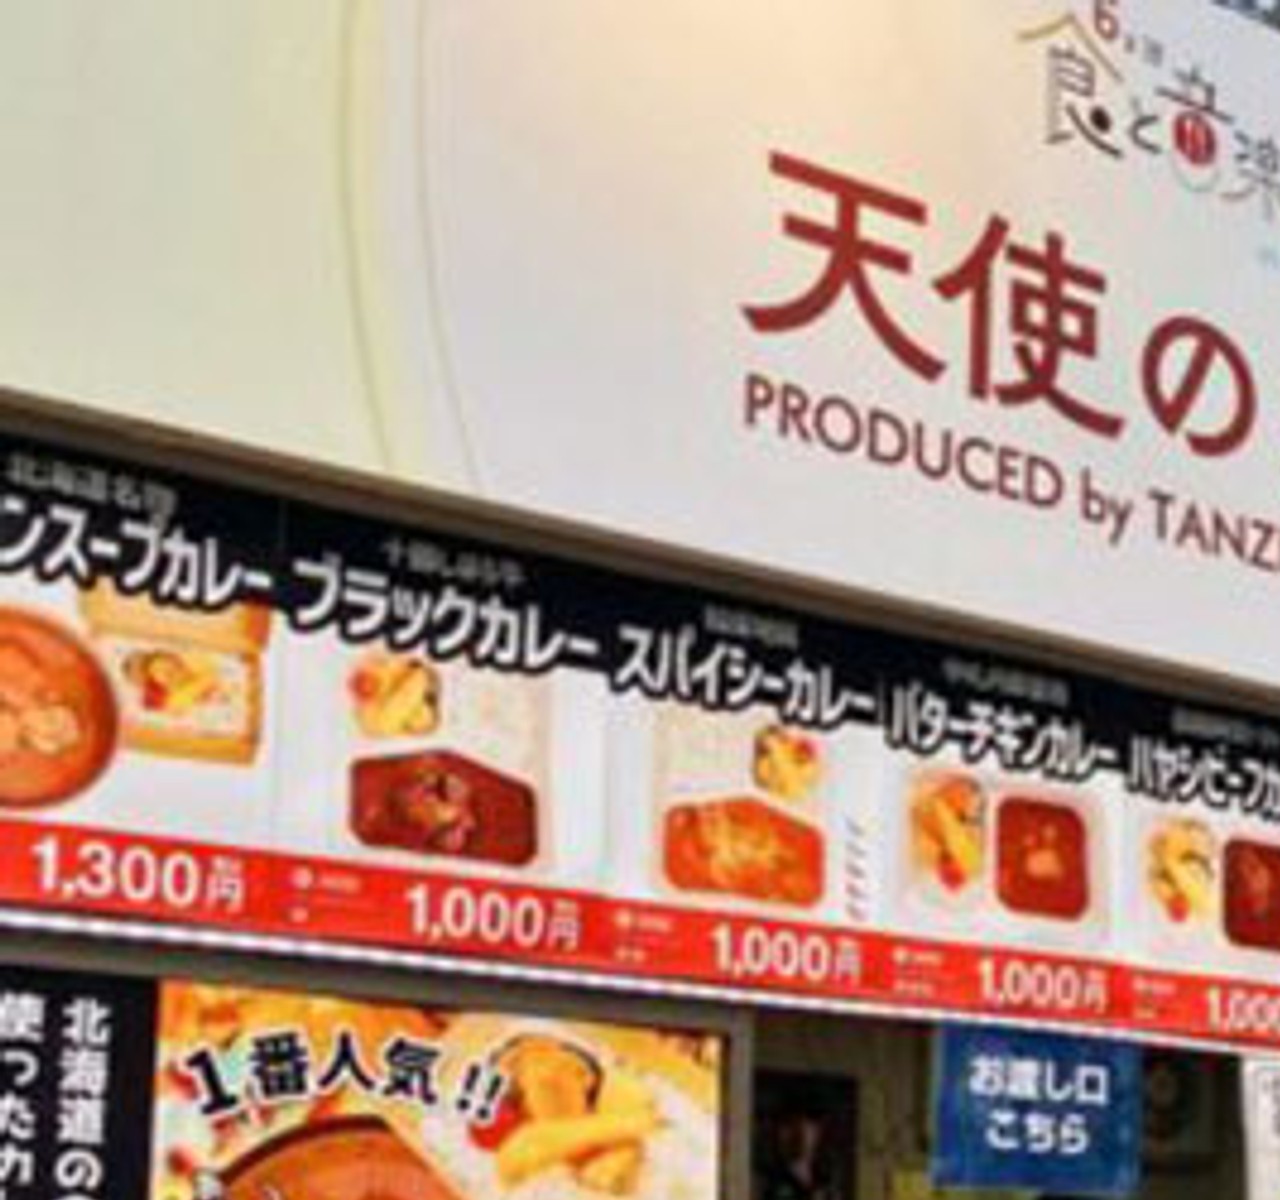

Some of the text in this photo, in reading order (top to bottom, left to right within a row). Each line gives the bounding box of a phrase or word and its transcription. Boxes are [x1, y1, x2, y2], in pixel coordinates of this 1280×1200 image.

[744, 373, 1062, 508] PRODUCED
[1078, 466, 1132, 546] by
[292, 556, 599, 668] ブラックカレー
[615, 622, 874, 730] スパイシーカレー
[969, 1054, 1111, 1106] お渡し口
[985, 1109, 1090, 1155] こちら
